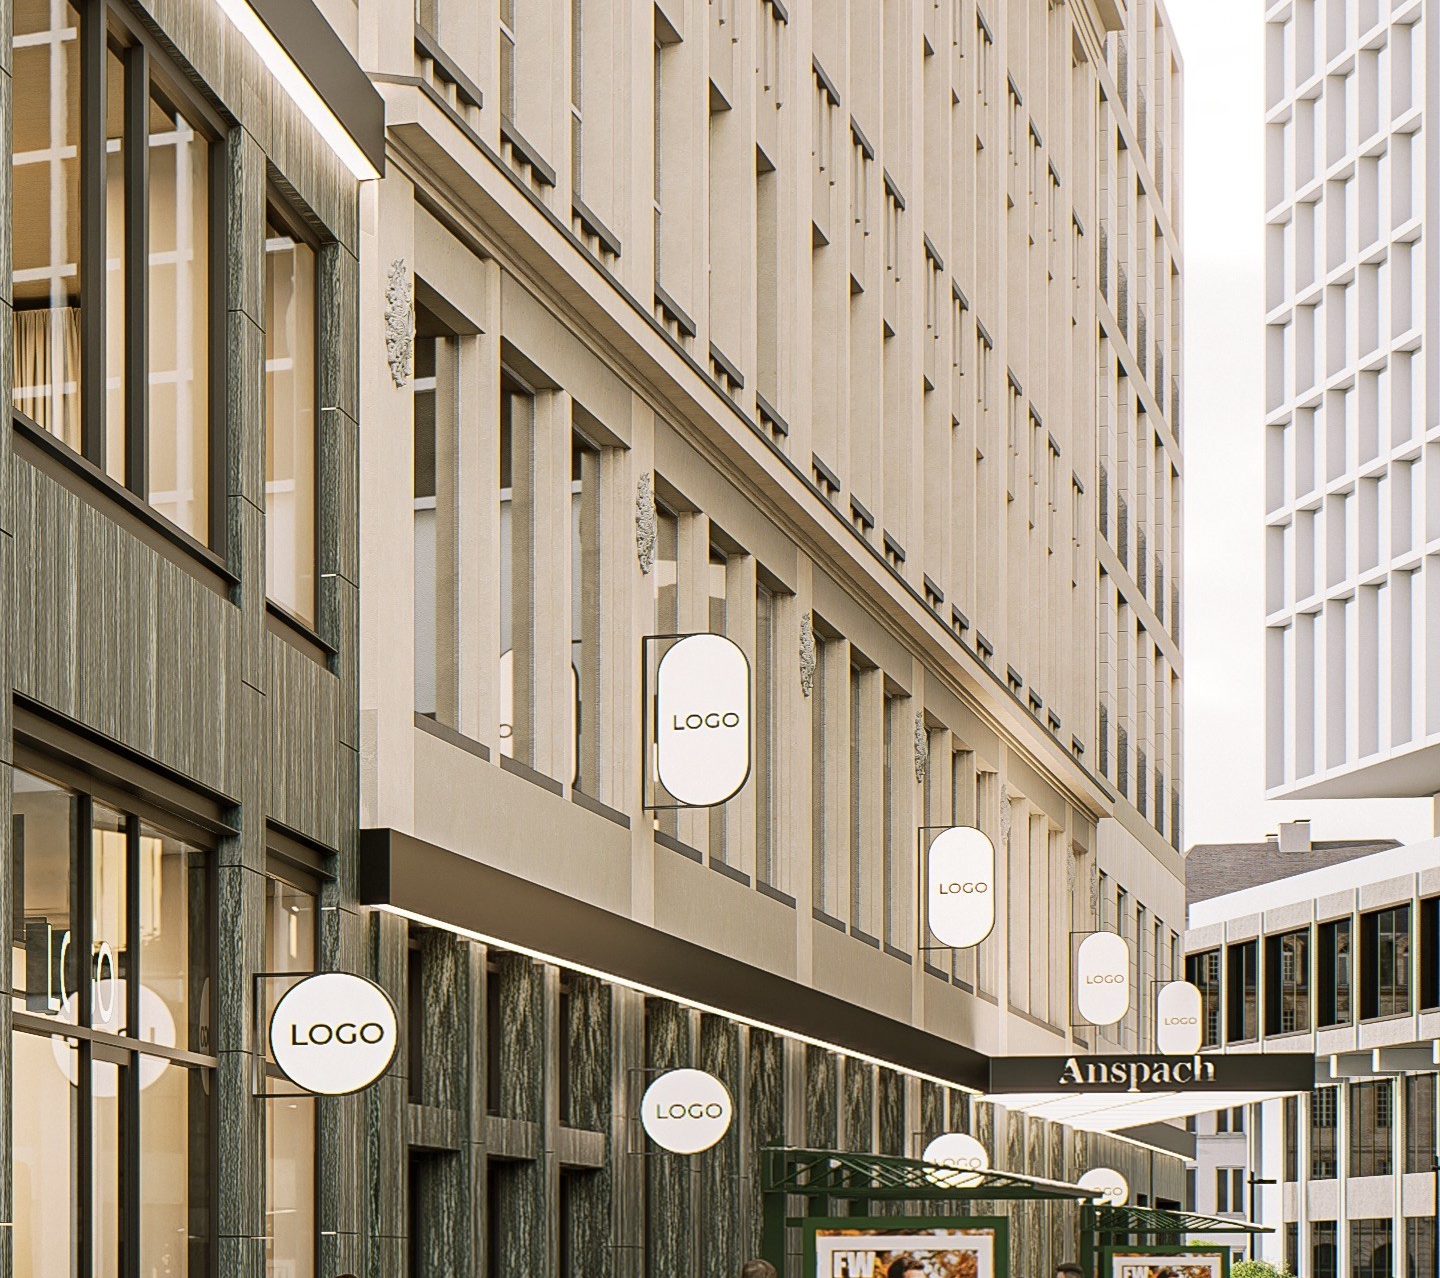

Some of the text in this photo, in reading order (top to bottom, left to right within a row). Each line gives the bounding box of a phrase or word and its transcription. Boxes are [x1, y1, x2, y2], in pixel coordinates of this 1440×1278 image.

[673, 712, 740, 731] LOGO
[939, 882, 988, 895] LOGO
[1086, 974, 1125, 985] LOGO
[1164, 1016, 1198, 1026] LOGO
[291, 1022, 385, 1047] LOGO
[1059, 1055, 1217, 1092] Anspach
[656, 1102, 723, 1120] LOGO
[833, 1251, 876, 1278] FW
